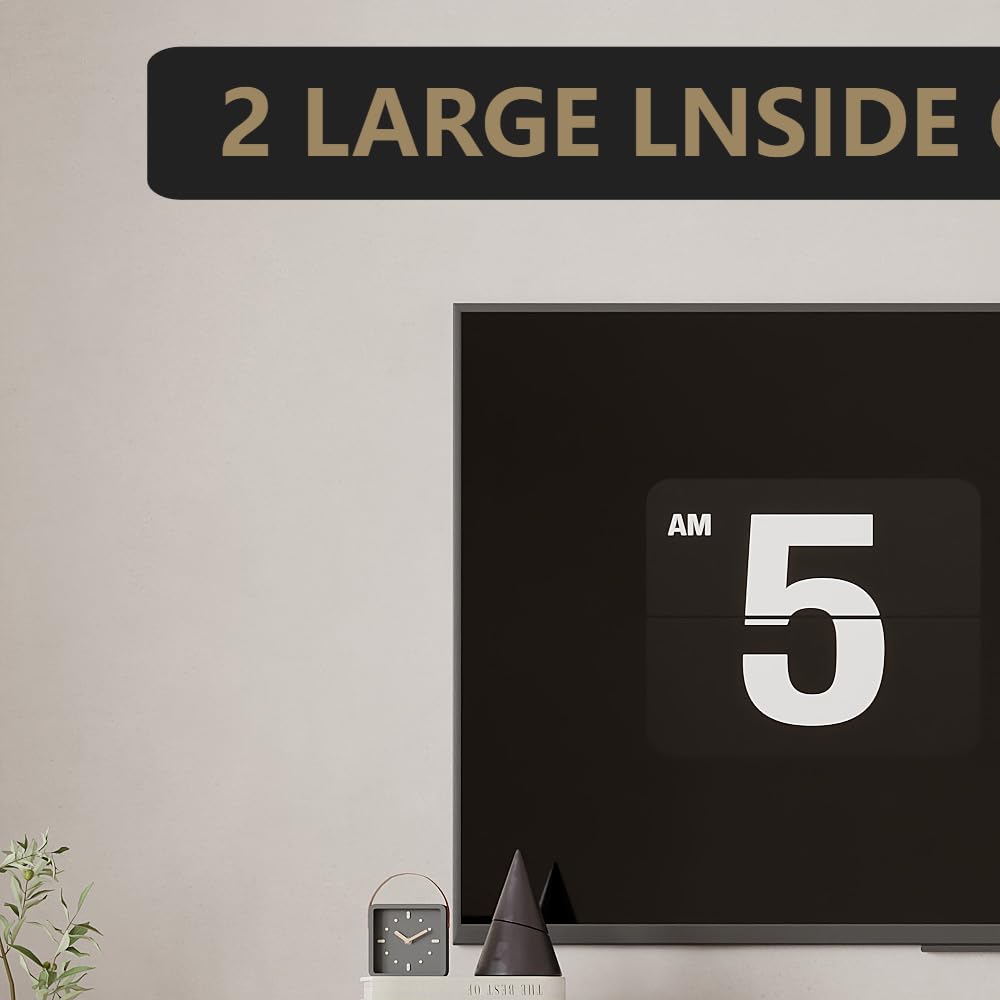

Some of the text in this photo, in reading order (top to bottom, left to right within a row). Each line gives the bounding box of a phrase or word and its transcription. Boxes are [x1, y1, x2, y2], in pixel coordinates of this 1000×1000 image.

[667, 513, 712, 537] AM
[742, 513, 886, 727] 5
[467, 983, 544, 996] THE BEST OF
